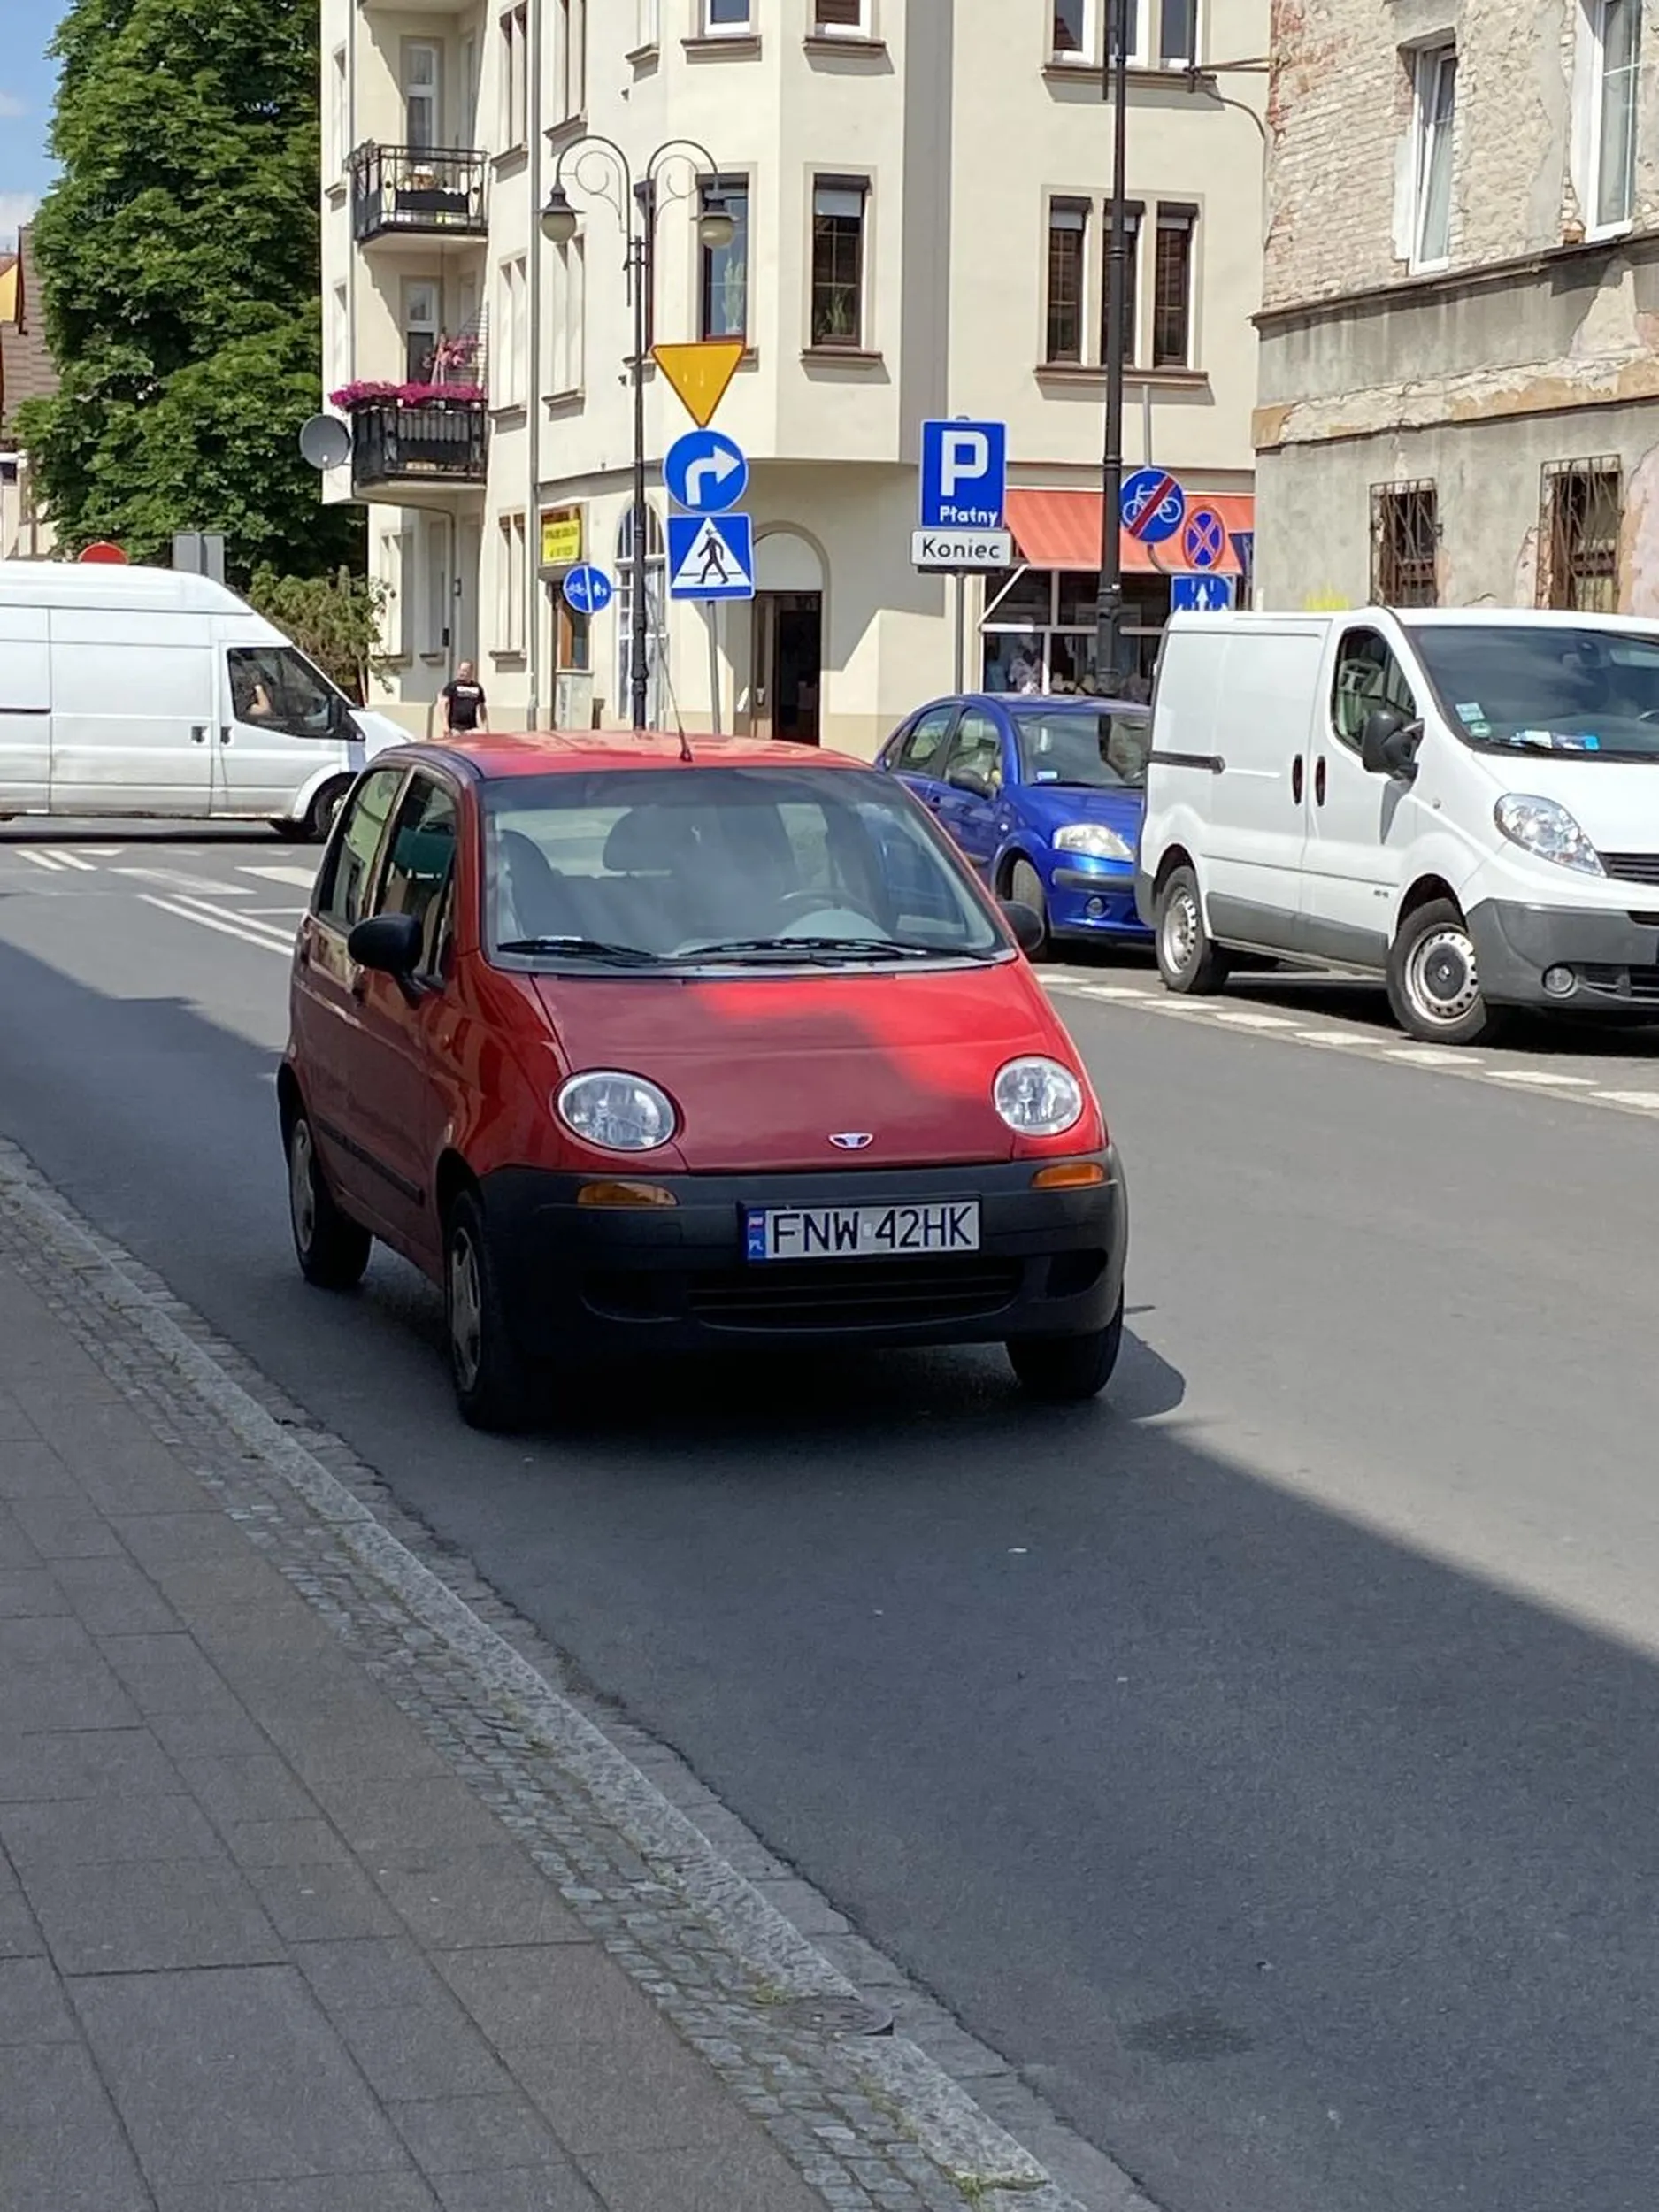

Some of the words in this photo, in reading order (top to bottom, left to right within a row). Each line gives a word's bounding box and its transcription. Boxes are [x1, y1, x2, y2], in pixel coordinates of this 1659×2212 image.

[941, 430, 989, 496] P
[939, 505, 998, 528] Płatny
[921, 537, 1001, 559] Koniec
[772, 1211, 860, 1254] FNW
[874, 1205, 972, 1249] 42HK
